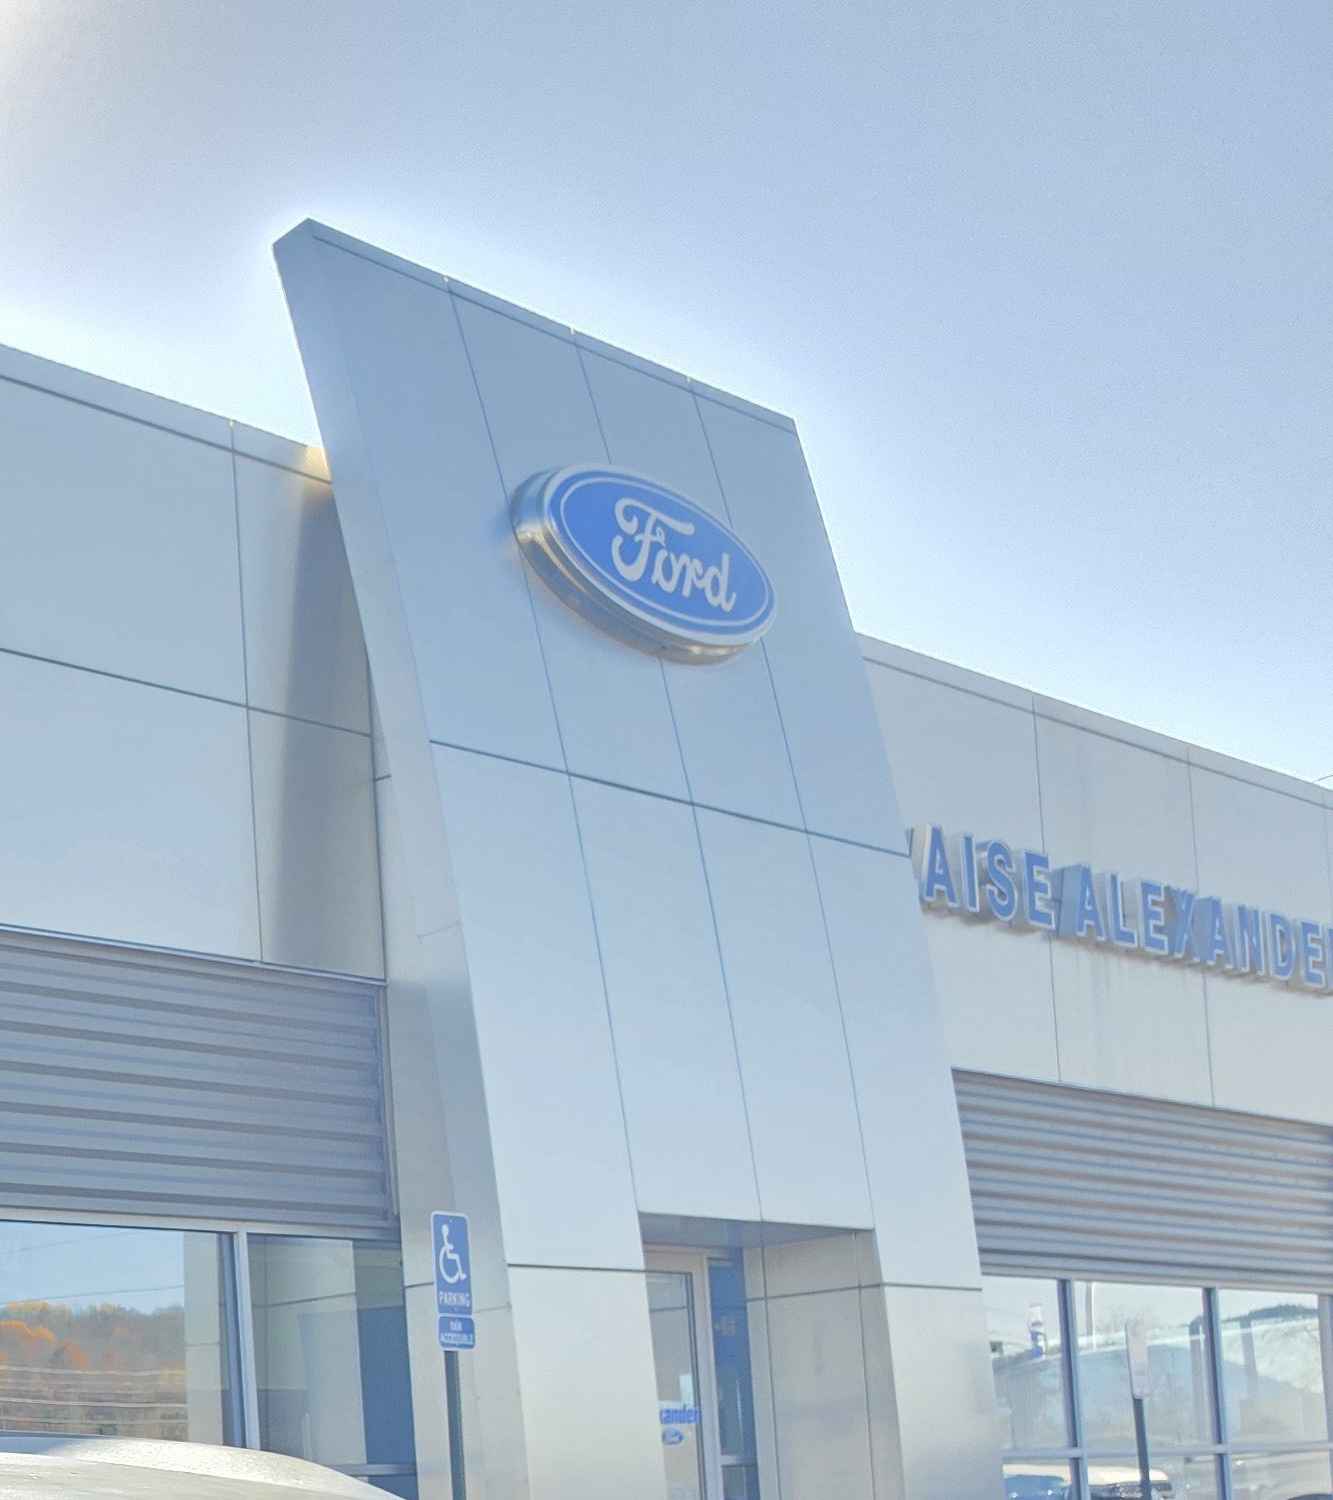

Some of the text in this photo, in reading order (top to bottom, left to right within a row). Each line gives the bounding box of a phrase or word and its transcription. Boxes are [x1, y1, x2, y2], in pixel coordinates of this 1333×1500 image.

[611, 497, 737, 612] Ford
[1073, 862, 1333, 989] ALEXANDE
[439, 1290, 471, 1307] PARKING
[659, 1405, 700, 1425] ander
